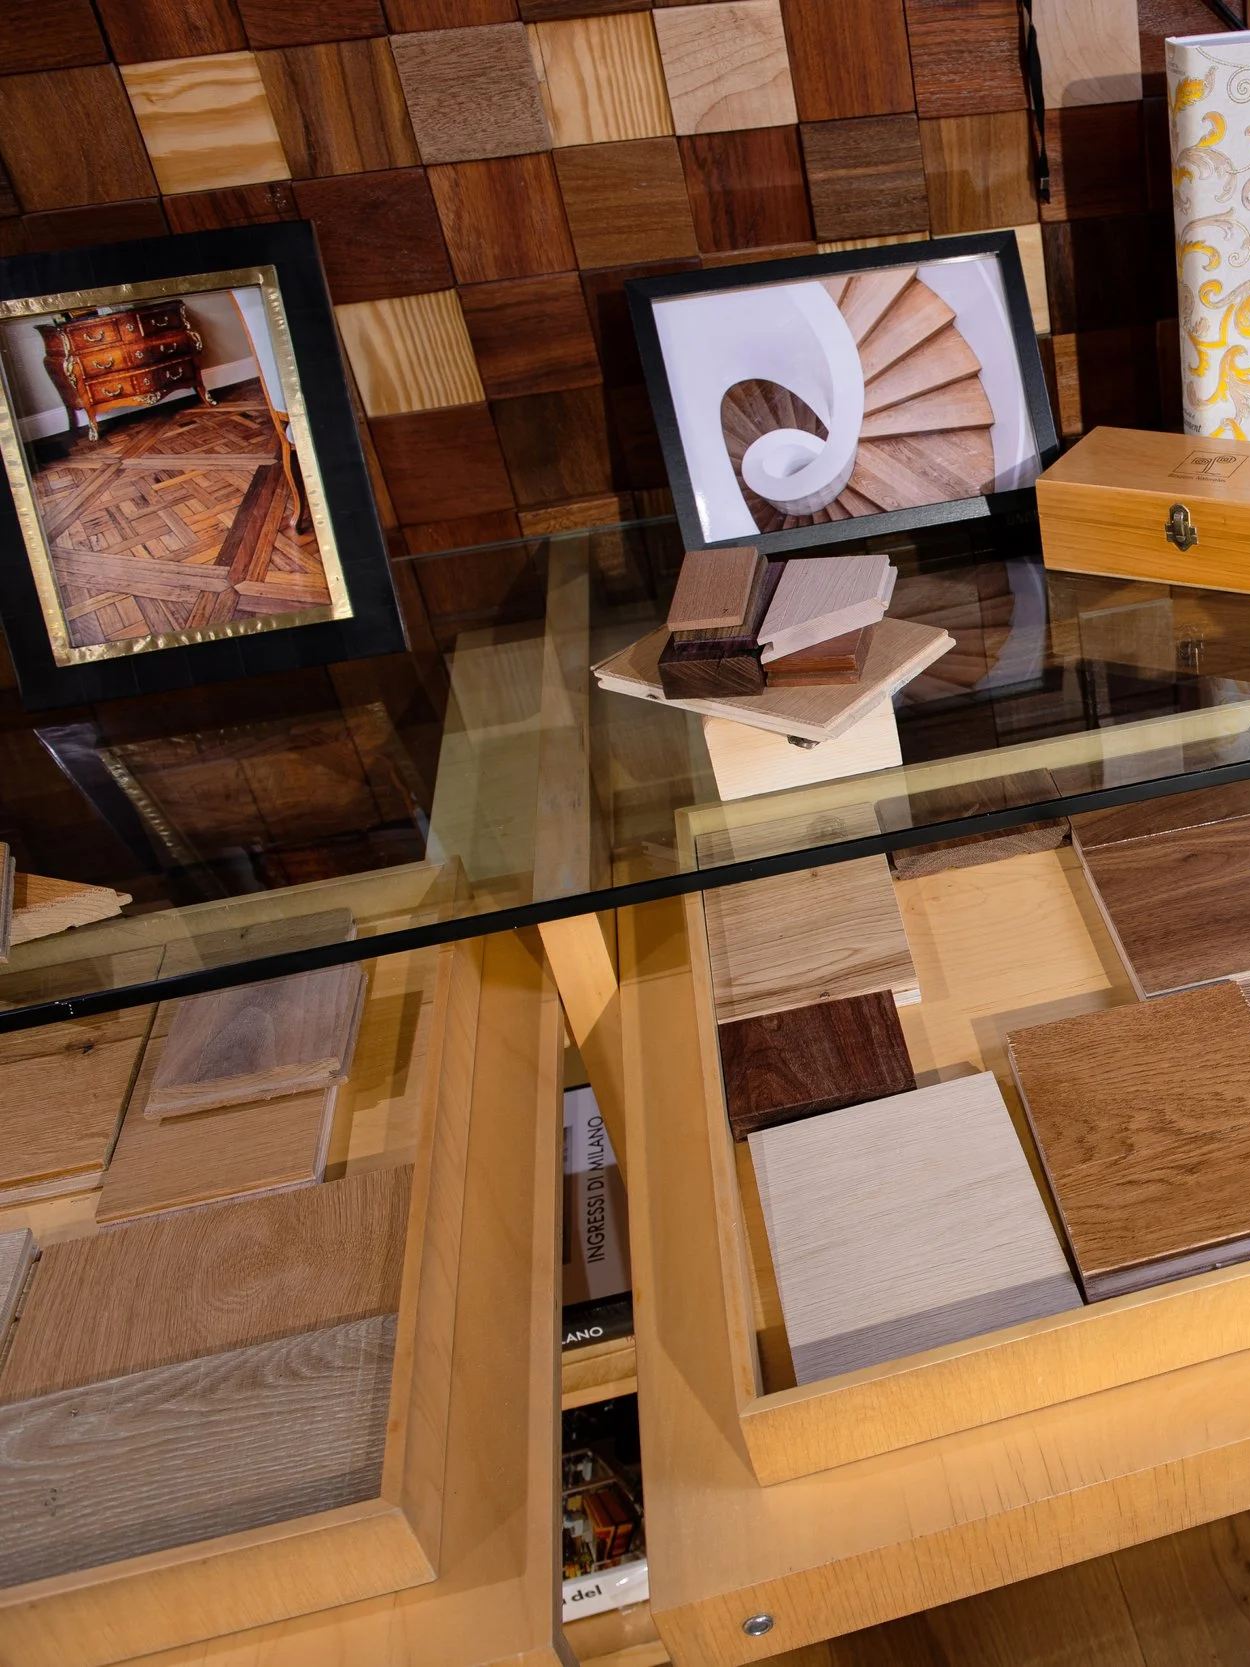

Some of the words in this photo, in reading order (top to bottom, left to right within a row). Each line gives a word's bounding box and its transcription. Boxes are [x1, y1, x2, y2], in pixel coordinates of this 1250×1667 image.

[587, 1115, 605, 1174] MILANO
[588, 1175, 604, 1191] DI
[587, 1194, 605, 1264] INGRESSI
[571, 1584, 602, 1602] del
